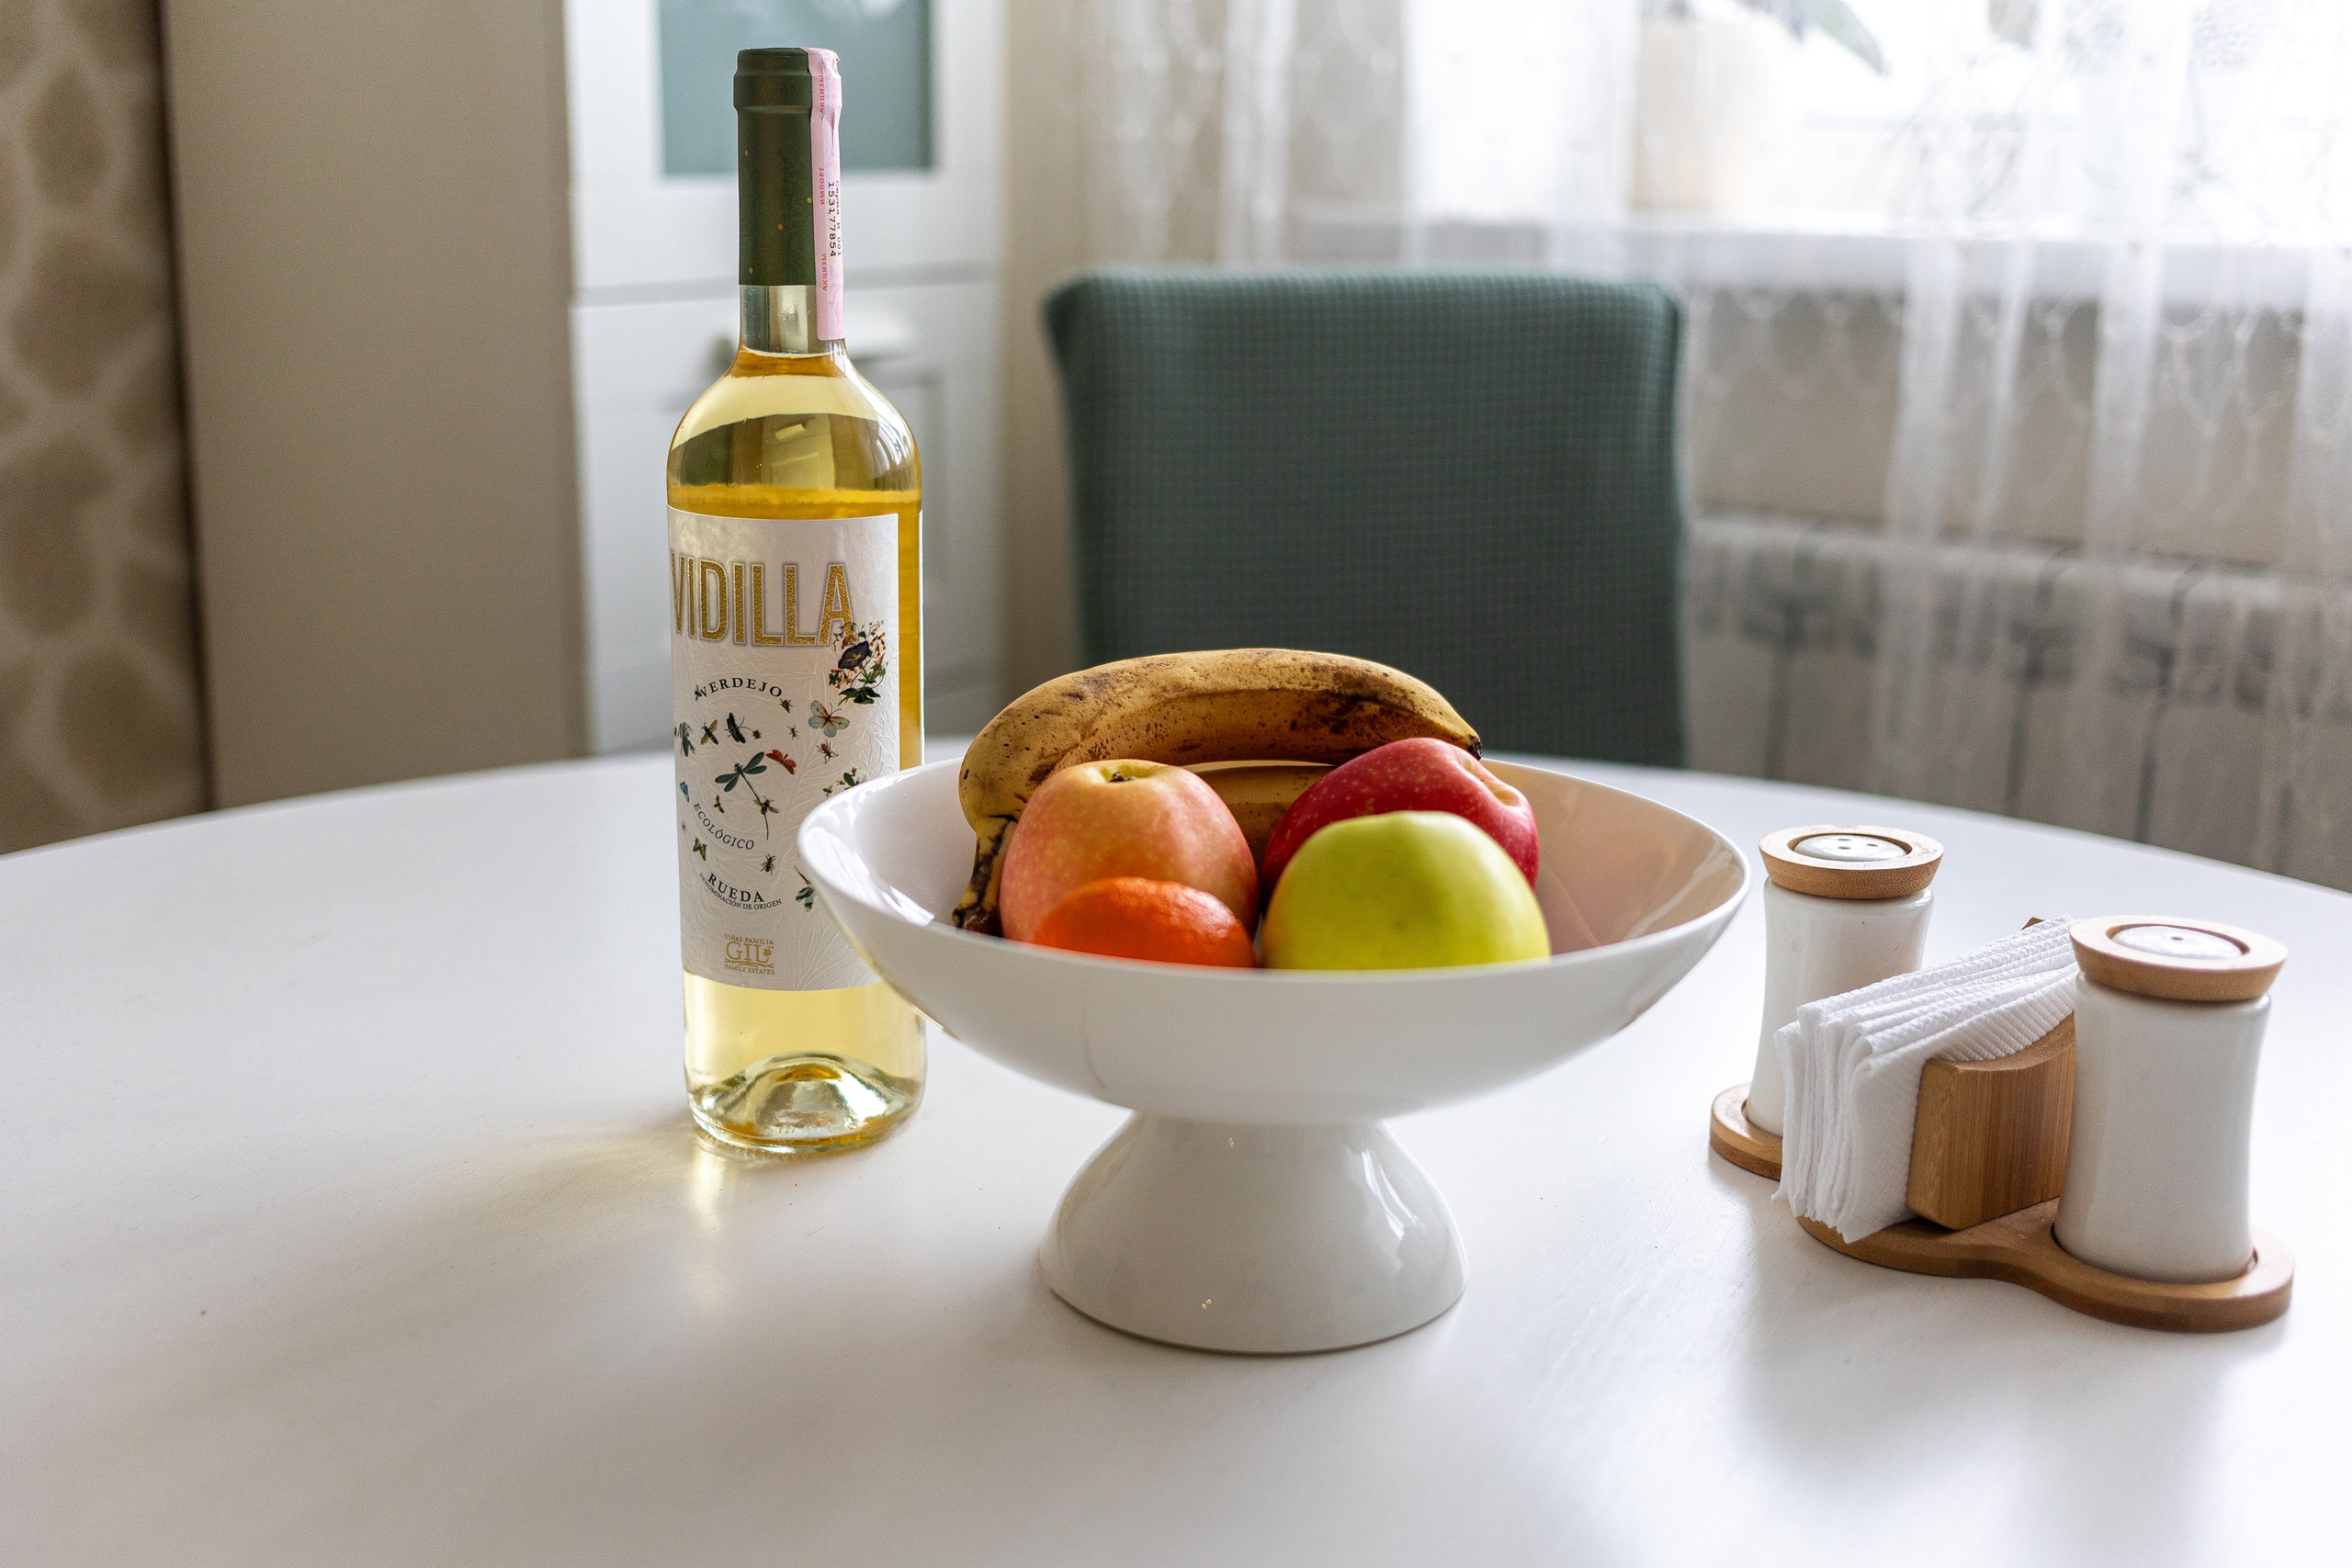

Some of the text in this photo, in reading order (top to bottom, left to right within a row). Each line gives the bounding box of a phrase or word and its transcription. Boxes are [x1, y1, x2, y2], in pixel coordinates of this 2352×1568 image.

[828, 182, 836, 256] 153177854
[670, 550, 855, 647] VIDILLA
[699, 677, 783, 699] VERDEJO
[694, 803, 754, 851] ECOLÓGICO
[699, 872, 741, 908] DENOMINACIÓN
[753, 898, 783, 910] ORIGEN
[707, 872, 764, 903] RUEDA
[726, 941, 770, 965] GIL
[745, 937, 774, 945] FAMILIA
[725, 964, 775, 976] FAMILY ESTATES
